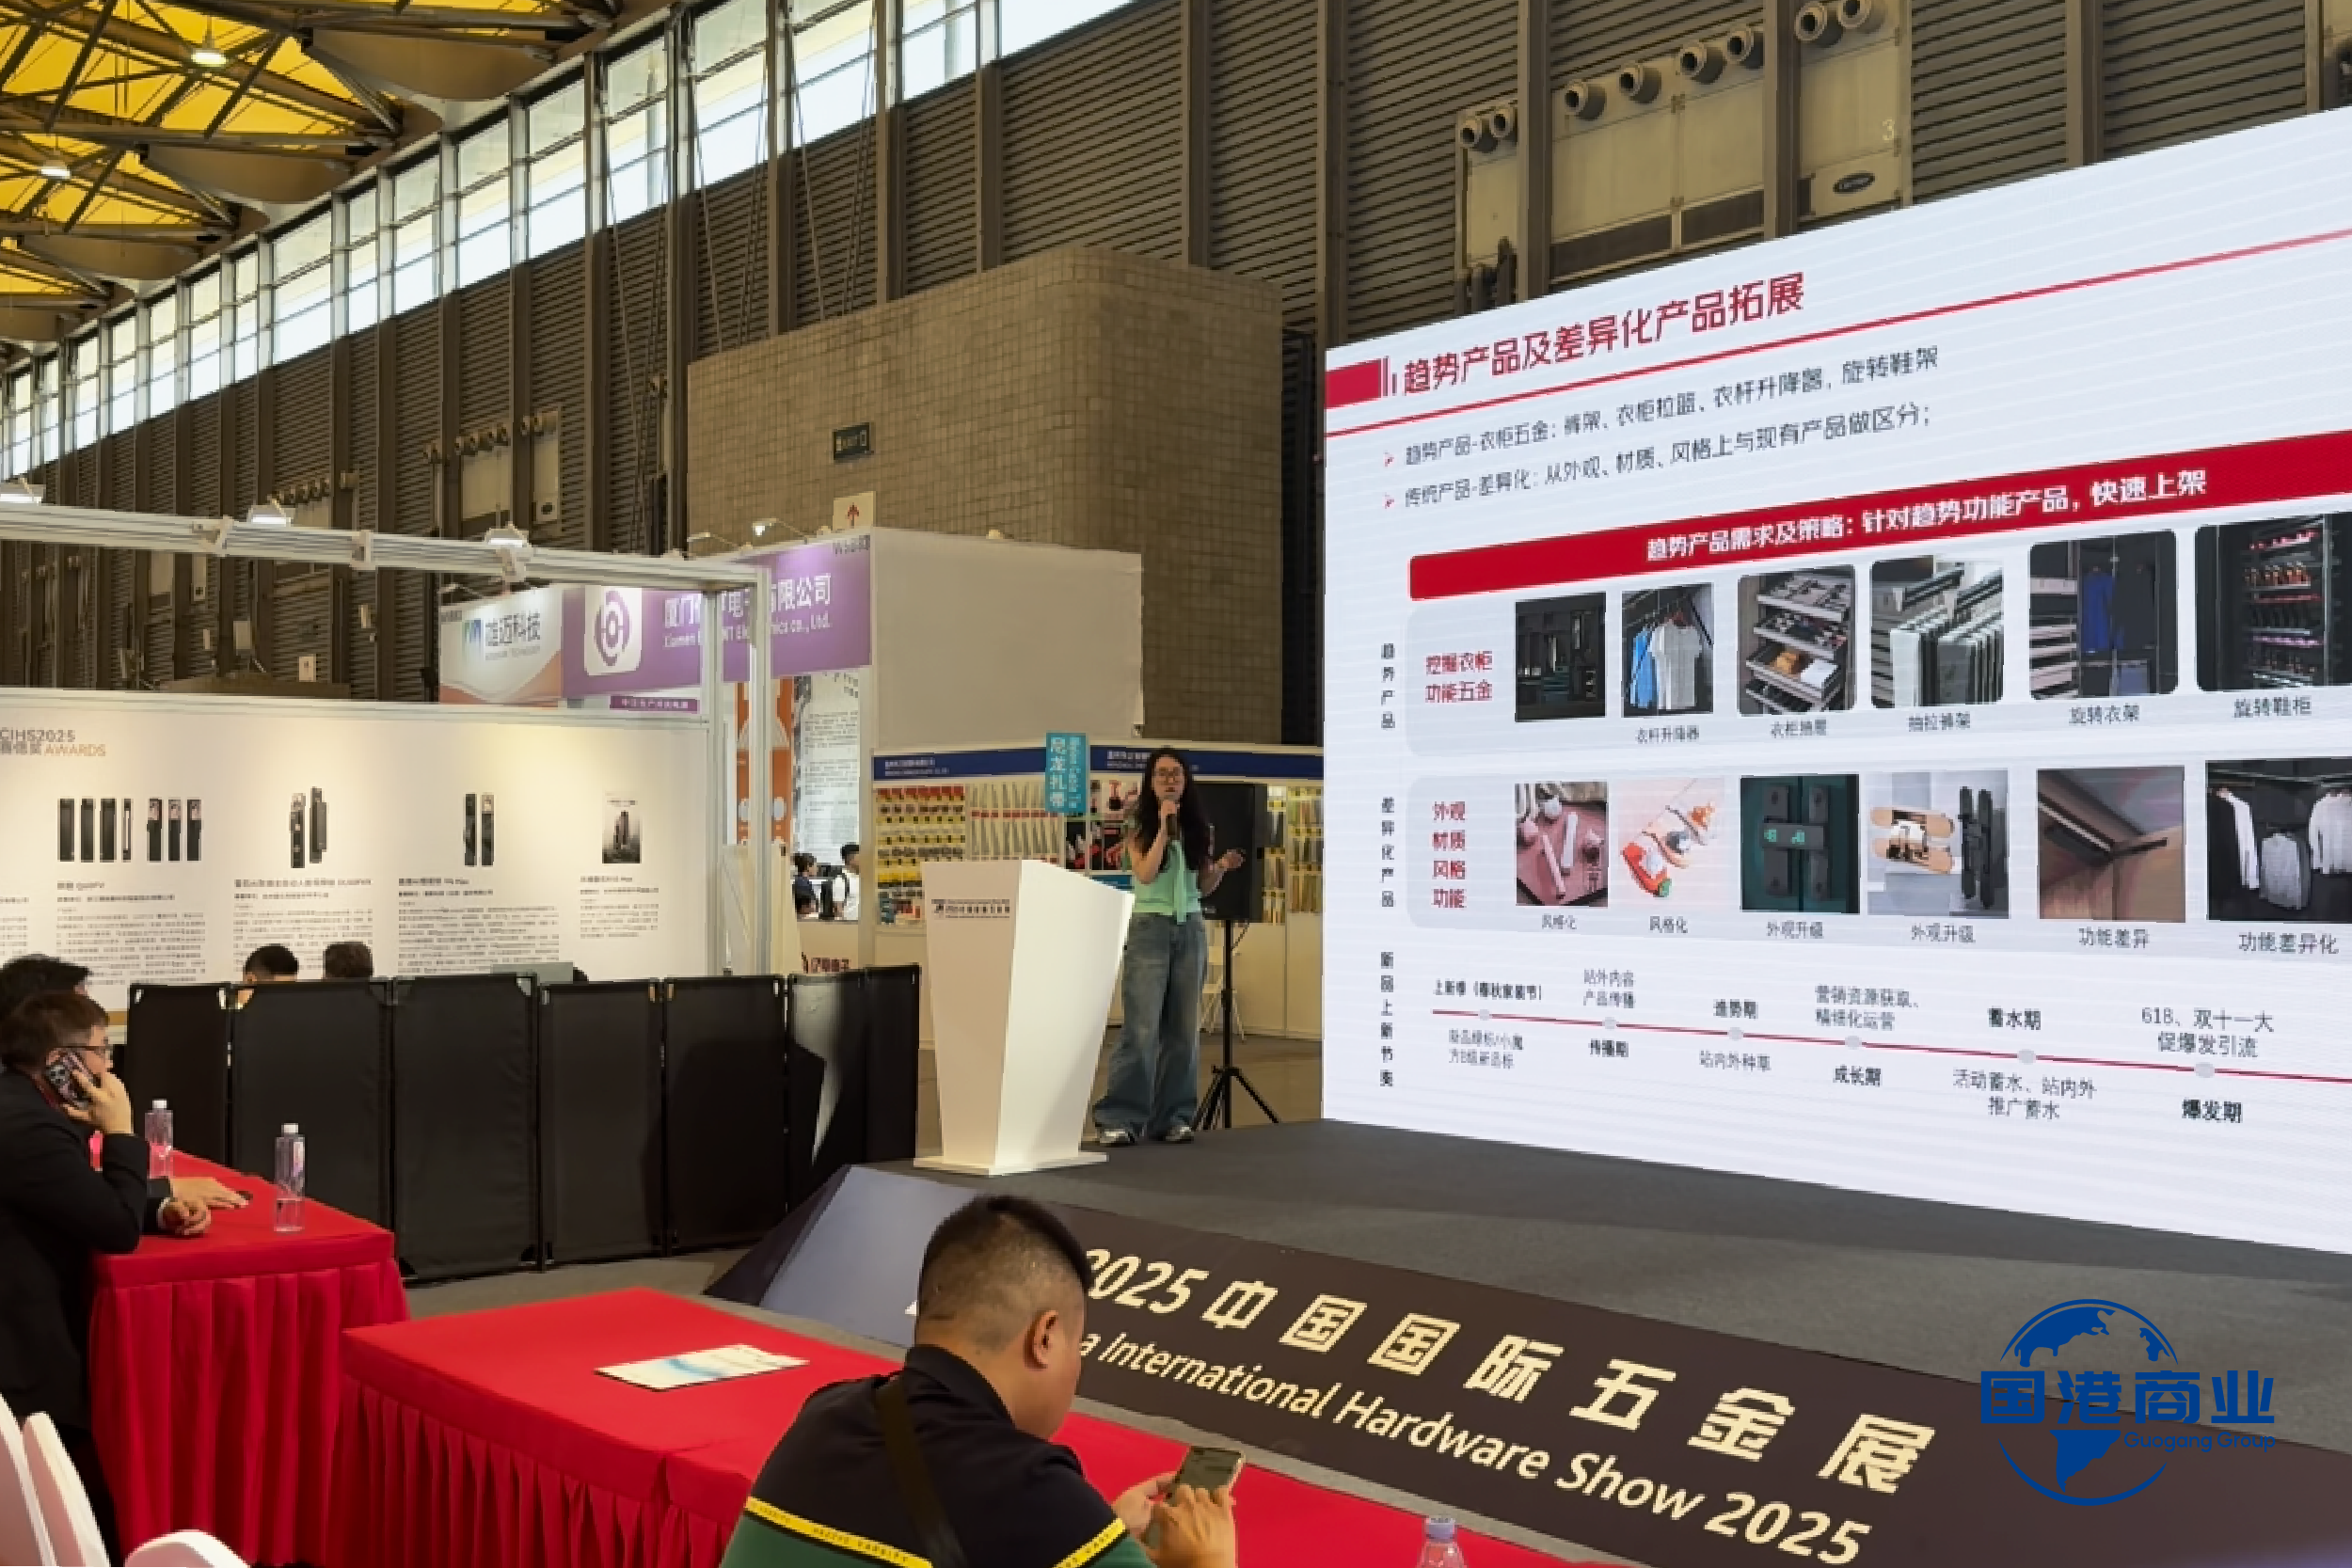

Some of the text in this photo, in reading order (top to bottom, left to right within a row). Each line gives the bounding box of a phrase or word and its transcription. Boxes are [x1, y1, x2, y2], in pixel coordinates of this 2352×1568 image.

[1404, 273, 1804, 395] 趋势产品及差异化产品拓展
[1425, 679, 1493, 704] 功能五金
[2069, 705, 2140, 725] 旋转衣架
[0, 727, 76, 743] CIHS2025
[44, 743, 106, 757] AWARDS
[1433, 801, 1467, 822] 外观
[1433, 831, 1467, 851] 材质
[1433, 860, 1467, 880] 风格
[1432, 888, 1467, 909] 功能
[1648, 915, 1689, 935] 风格化
[2079, 926, 2150, 949] 功能差异
[2238, 931, 2339, 956] 功能差异化
[2141, 1006, 2274, 1034] 618、双十一大
[2157, 1032, 2258, 1058] 促爆发引流
[1834, 1066, 1882, 1088] 成长期
[1988, 1096, 2060, 1120] 推广蓄水
[2182, 1099, 2243, 1124] 爆发期
[1099, 1331, 1871, 1565] International Hardware Show 2025
